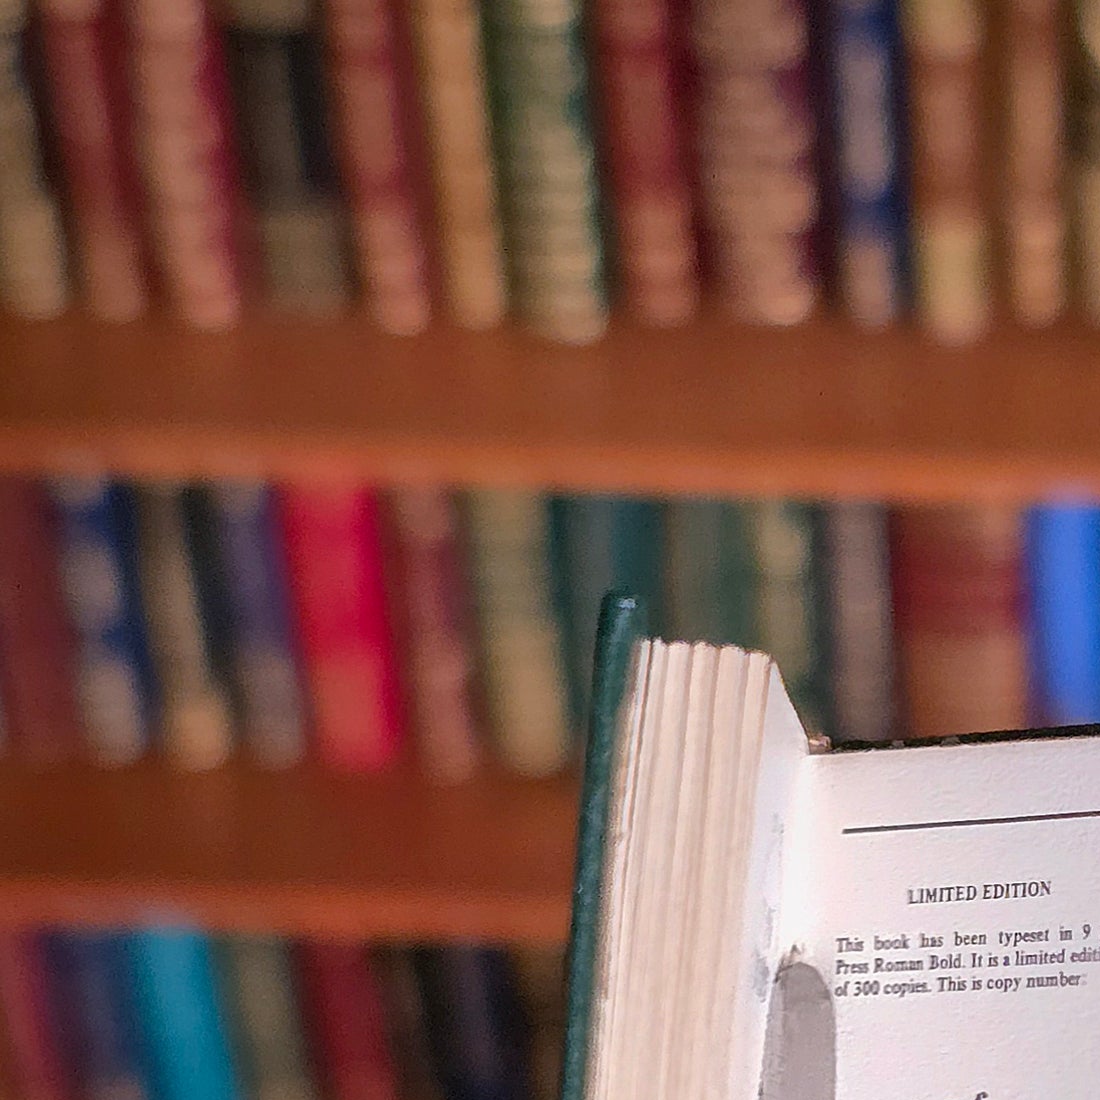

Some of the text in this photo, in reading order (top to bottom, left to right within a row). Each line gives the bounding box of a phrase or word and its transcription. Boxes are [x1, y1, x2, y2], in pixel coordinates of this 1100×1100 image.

[908, 880, 1052, 904] LIMITED EDITION
[836, 937, 864, 952] This
[874, 935, 910, 950] book
[919, 933, 944, 948] has
[954, 931, 986, 946] been
[999, 928, 1050, 946] typeset
[1060, 926, 1072, 940] in
[1082, 924, 1091, 938] 9
[836, 960, 869, 974] Press
[874, 958, 923, 973] Roman
[928, 954, 966, 970] Bold.
[971, 954, 983, 968] It
[988, 952, 998, 966] is
[1003, 955, 1010, 966] a
[1015, 950, 1064, 964] limited
[834, 980, 851, 997] of
[854, 980, 879, 996] 300
[883, 979, 931, 998] copies.
[938, 977, 966, 992] This
[972, 976, 982, 990] is
[986, 976, 1022, 992] copy
